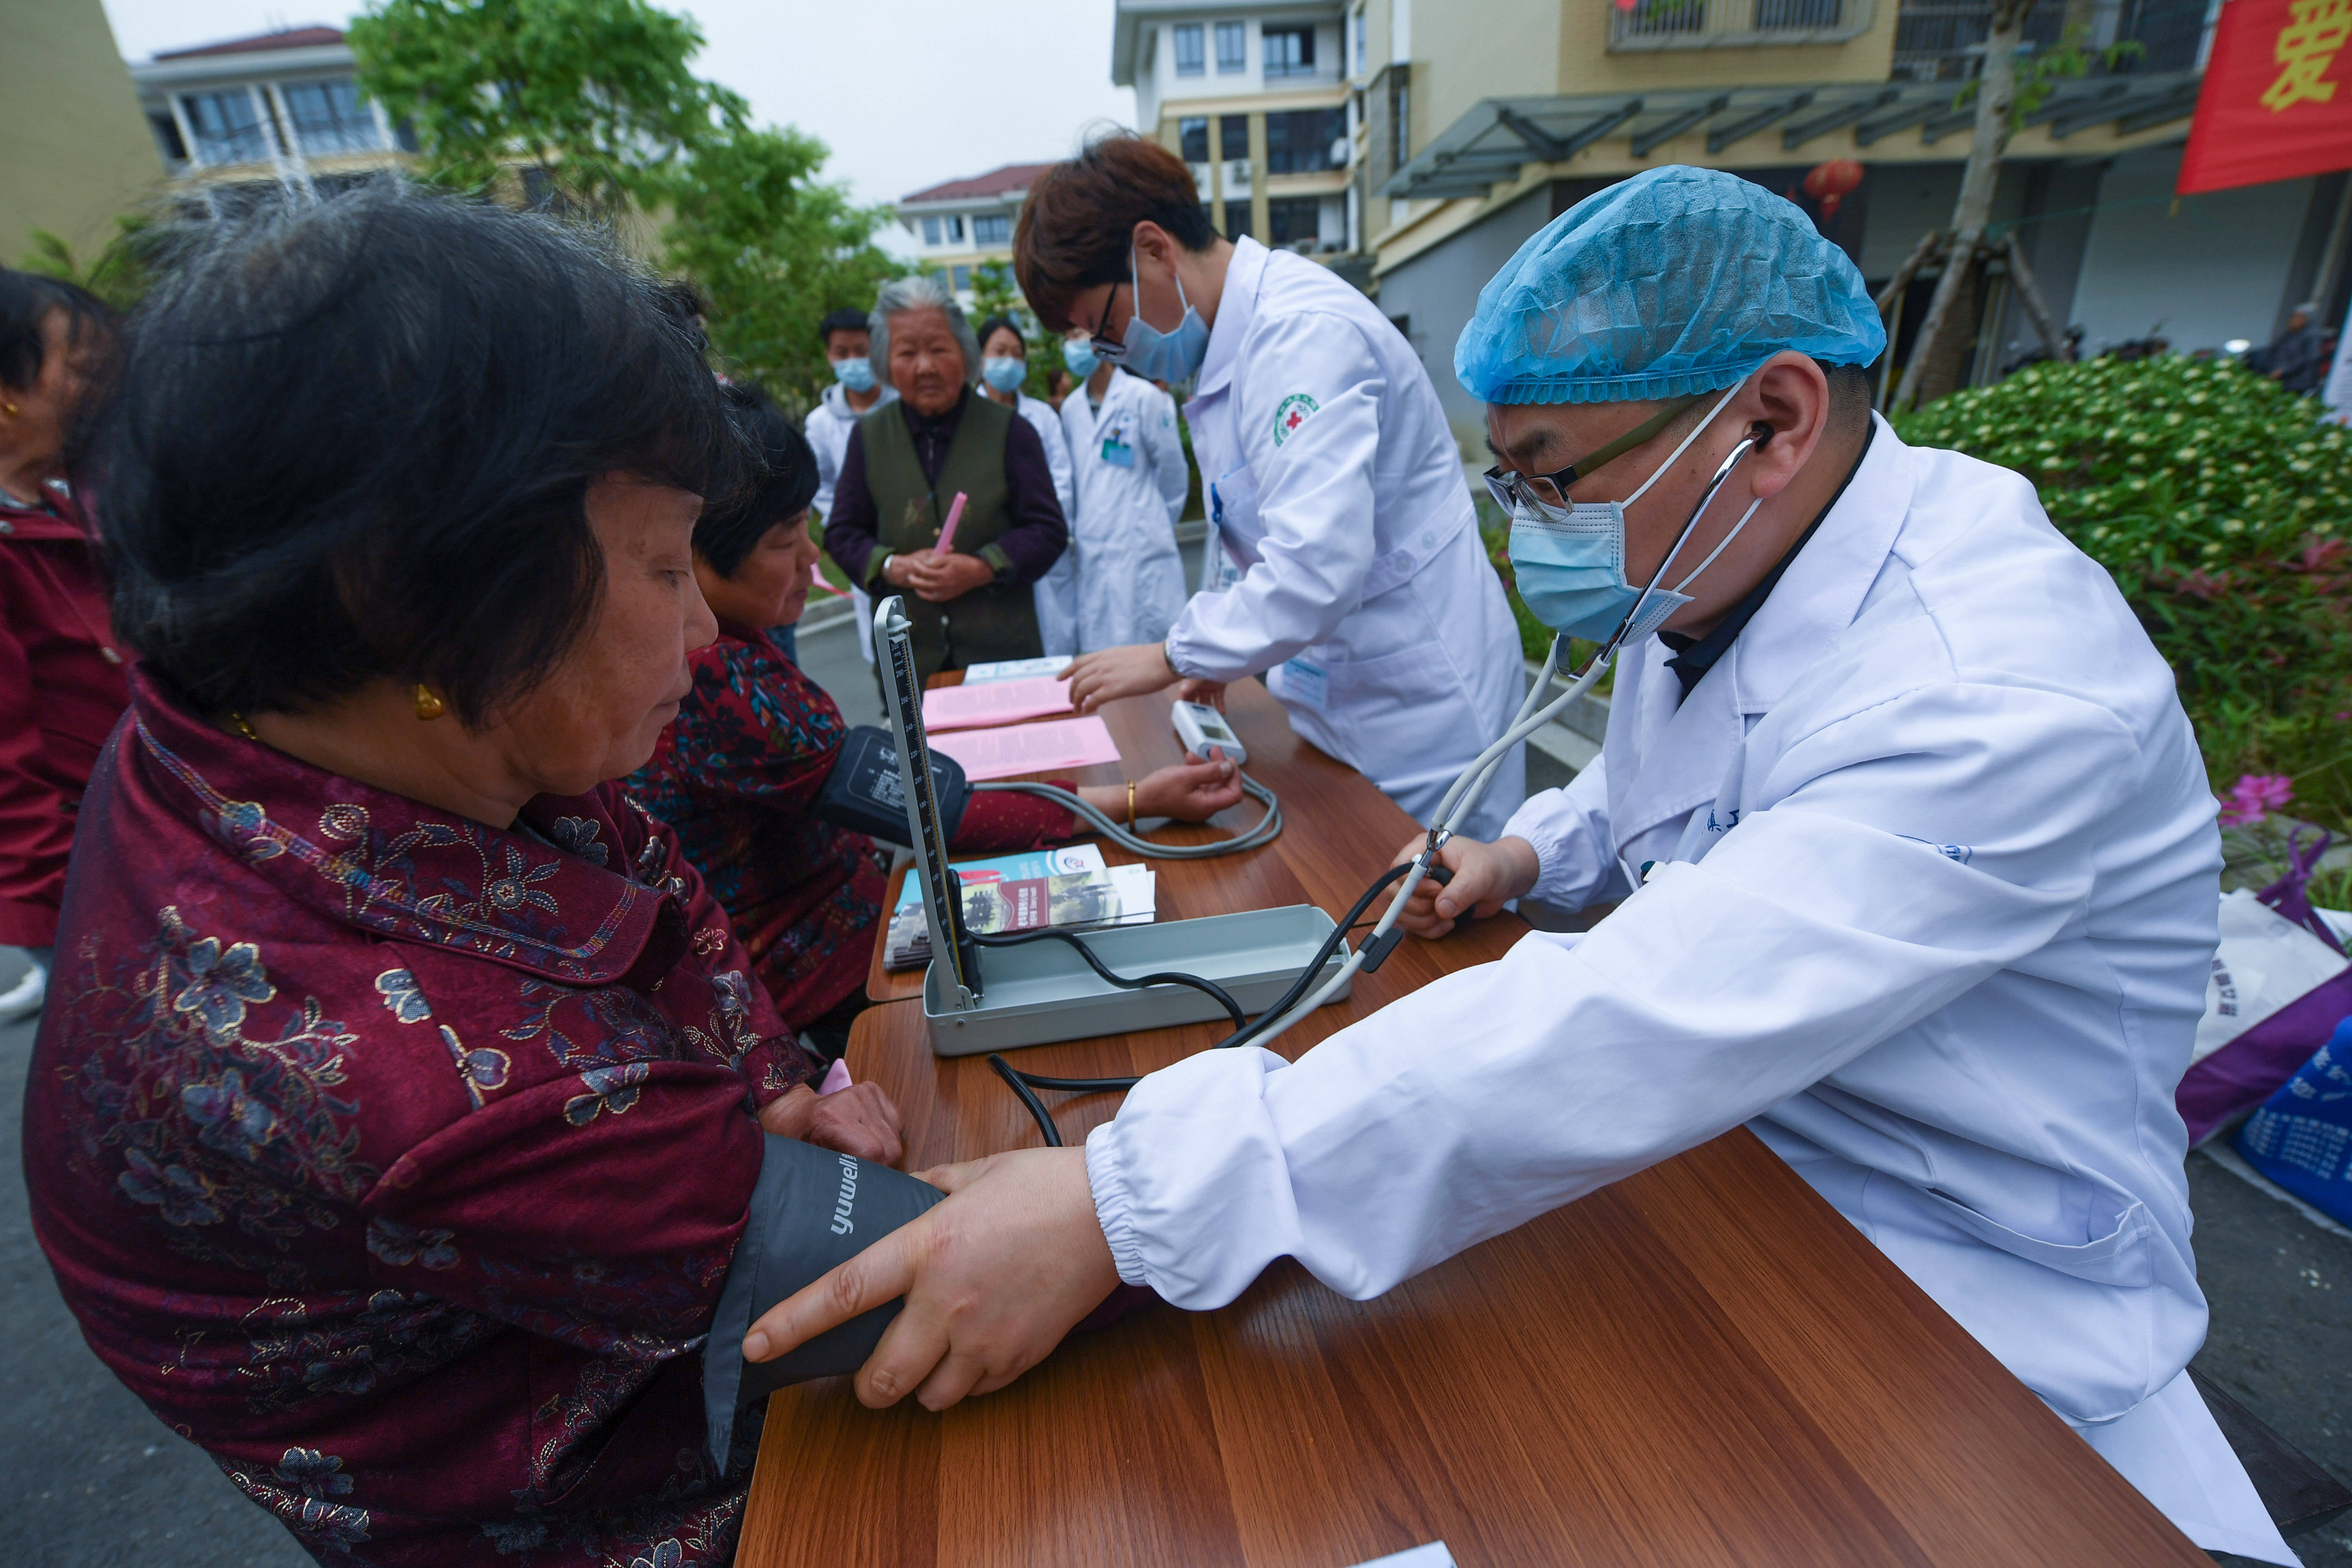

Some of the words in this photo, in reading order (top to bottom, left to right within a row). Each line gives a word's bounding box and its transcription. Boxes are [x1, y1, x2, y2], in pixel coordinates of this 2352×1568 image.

[2260, 0, 2352, 113] 爱
[896, 669, 904, 678] 280
[901, 696, 909, 705] 260
[905, 723, 913, 732] 240
[910, 750, 918, 759] 220
[830, 1157, 858, 1235] yuwell
